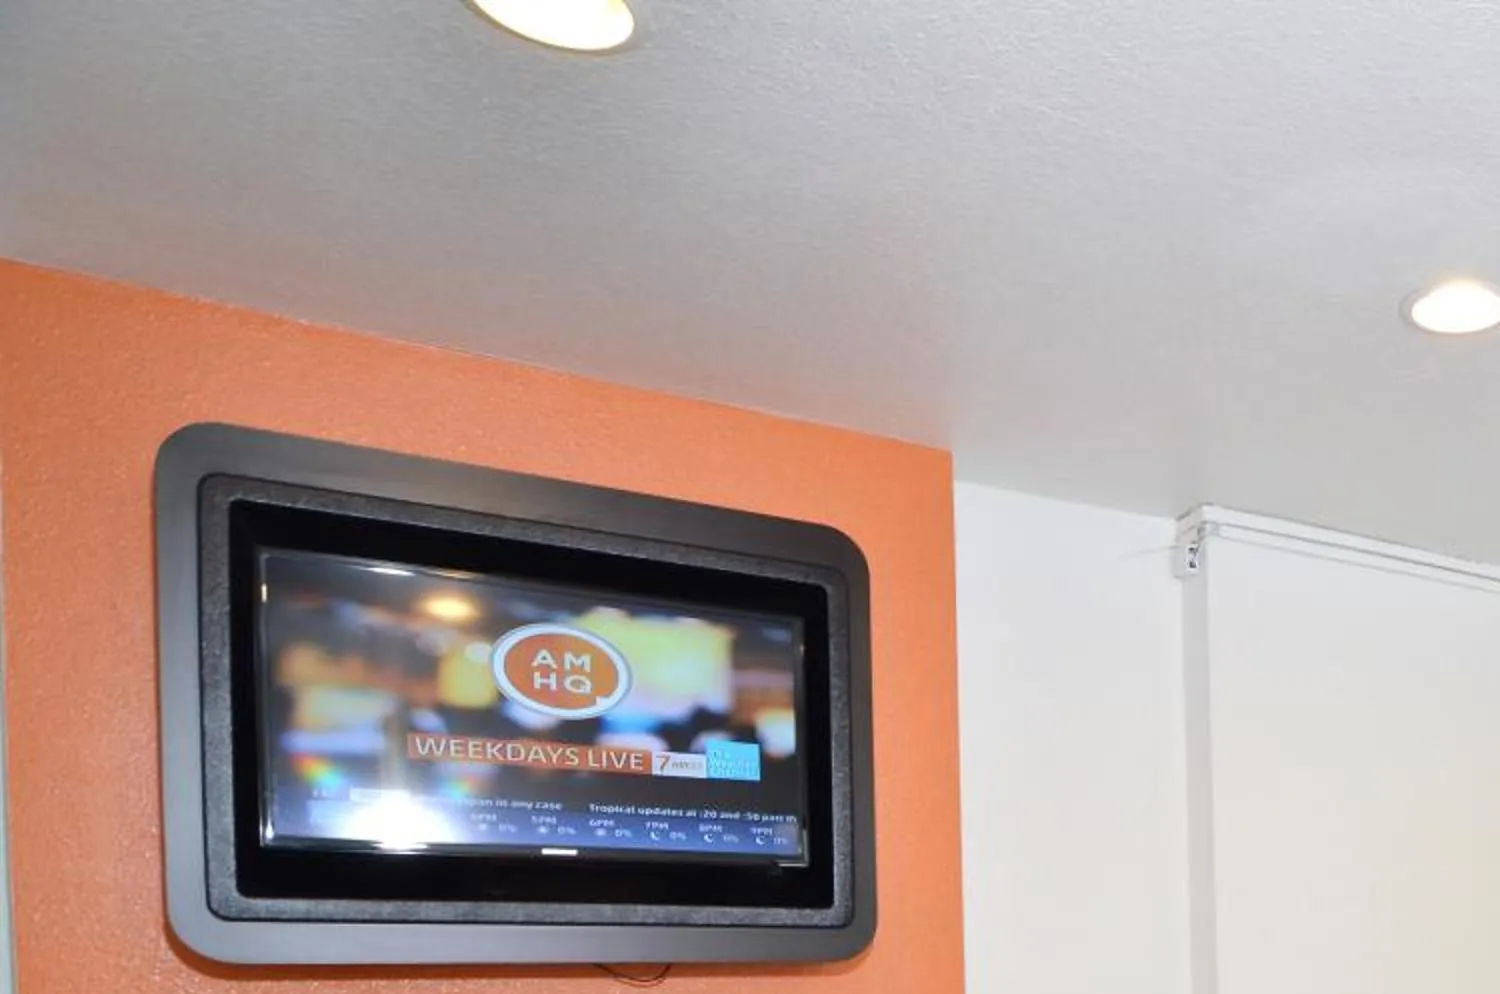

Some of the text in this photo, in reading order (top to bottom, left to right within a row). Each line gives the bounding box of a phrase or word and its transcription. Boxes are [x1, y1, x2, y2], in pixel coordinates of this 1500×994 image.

[531, 648, 592, 672] AM
[533, 671, 593, 696] HQ
[414, 735, 580, 767] WEEKDAYS
[587, 748, 644, 771] LIVE
[655, 754, 671, 773] 7
[534, 800, 563, 811] case
[588, 802, 636, 815] Tropical
[638, 806, 683, 818] updates
[719, 810, 741, 820] and
